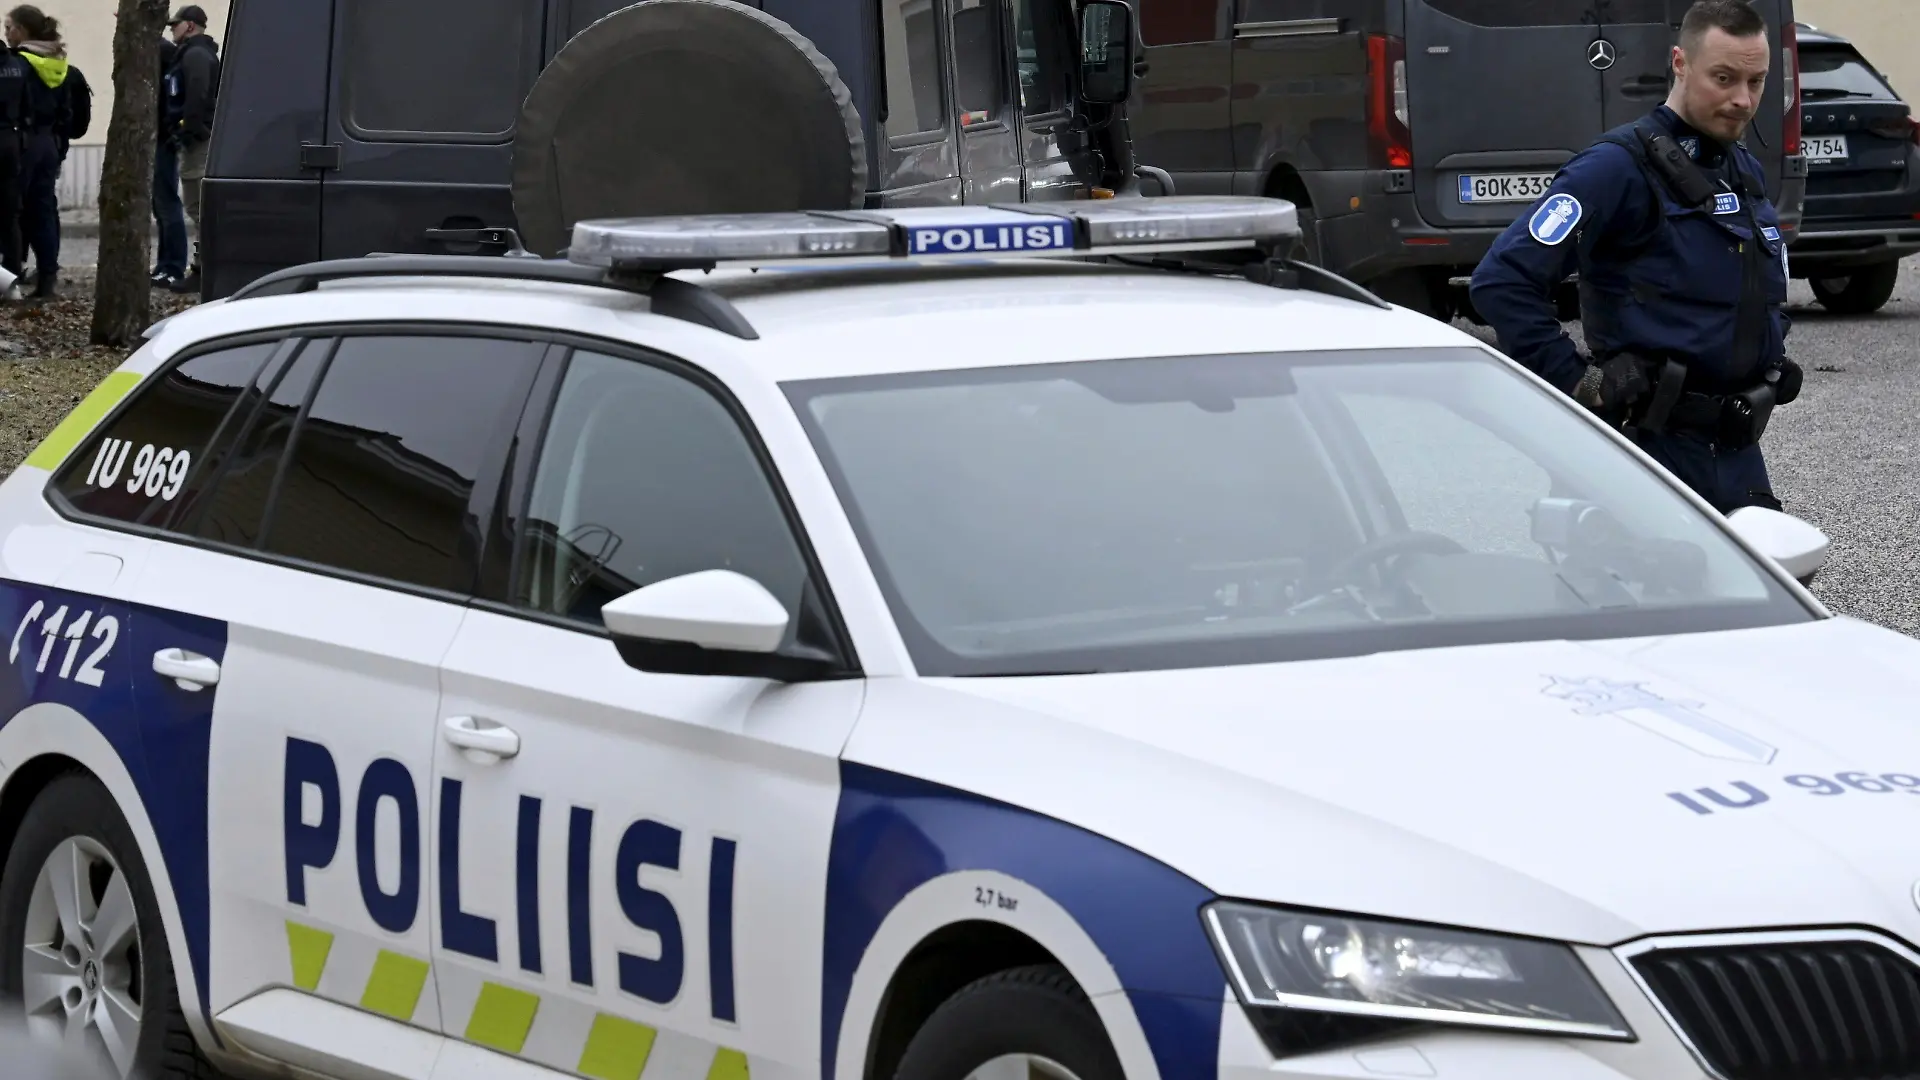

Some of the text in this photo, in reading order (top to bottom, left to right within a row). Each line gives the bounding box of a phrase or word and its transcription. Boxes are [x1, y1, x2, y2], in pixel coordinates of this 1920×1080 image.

[0, 68, 22, 78] LIISI
[1800, 139, 1844, 156] R-754
[1715, 203, 1731, 211] LIS
[1716, 196, 1732, 204] IISI
[915, 225, 1064, 252] POLIISI
[86, 437, 191, 501] IU 969
[35, 604, 119, 688] 112
[1665, 771, 1920, 815] IU 969
[283, 735, 737, 1023] POLIISI
[975, 886, 1018, 912] 2,7 bar
